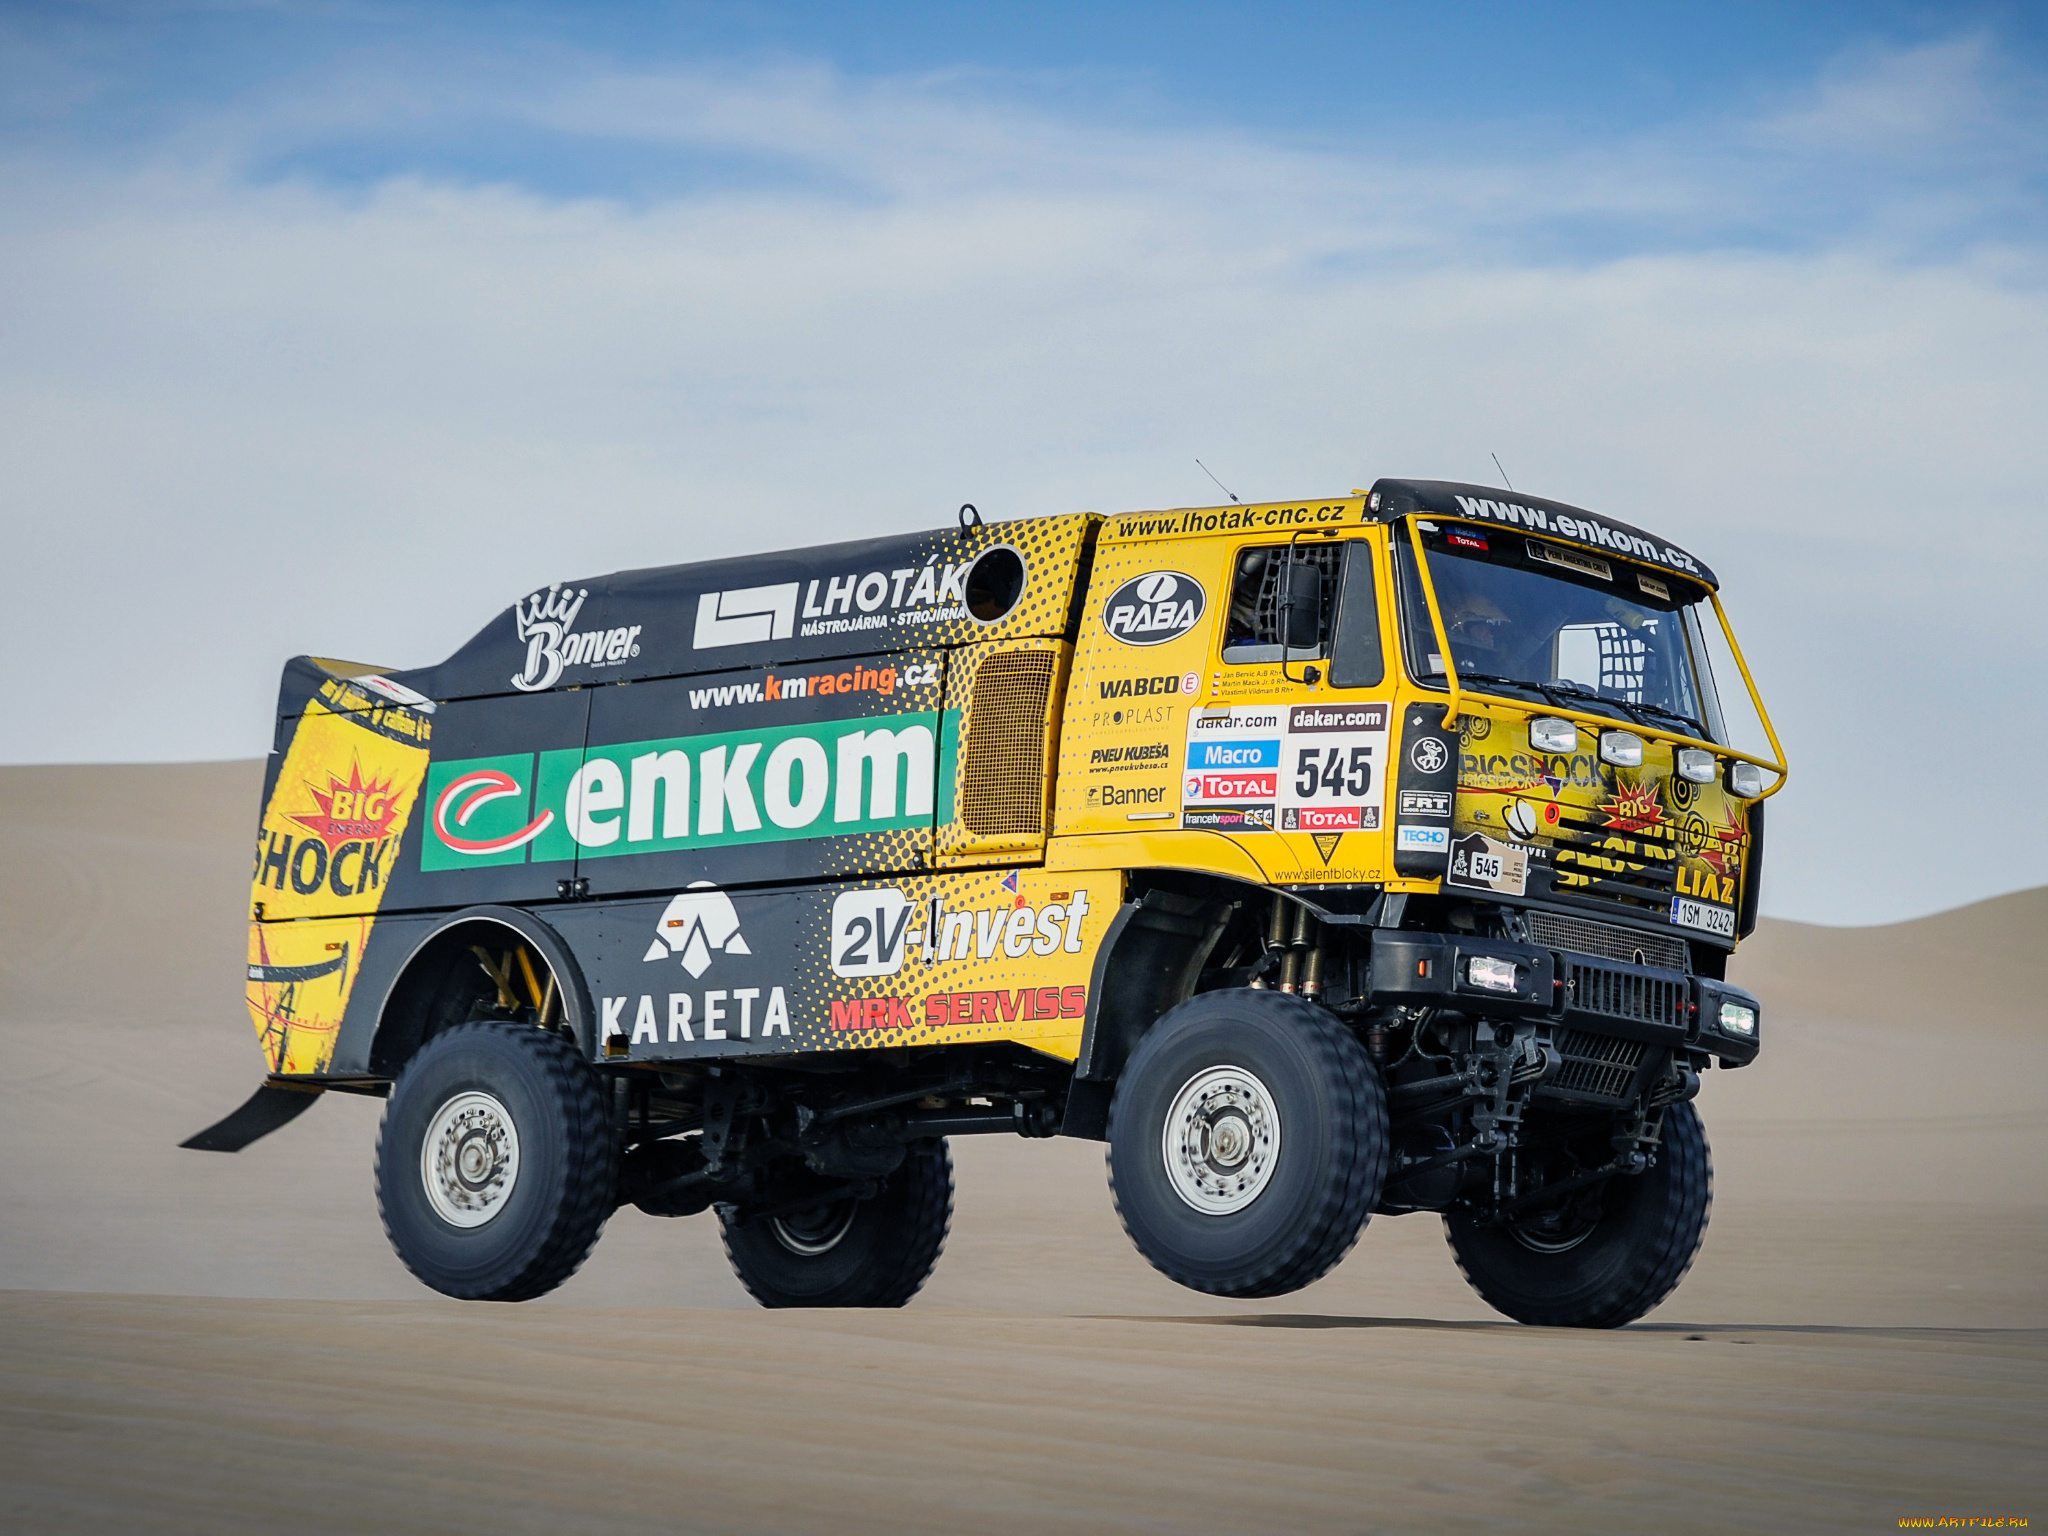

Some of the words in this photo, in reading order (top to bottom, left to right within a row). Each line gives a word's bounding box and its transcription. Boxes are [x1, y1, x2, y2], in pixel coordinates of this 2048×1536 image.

[1118, 502, 1346, 537] www.lhotak-cnc.cz
[1455, 494, 1700, 573] www.enkom.cz
[802, 554, 974, 619] LHOTÁK
[801, 614, 888, 637] NÁSTROJÁRNA
[897, 606, 966, 627] STROJÍRNA
[1109, 599, 1196, 634] RABA
[688, 661, 939, 711] www.kmracing.cz
[1100, 676, 1180, 699] WABCO
[1092, 706, 1175, 727] PROPLAST
[1294, 709, 1381, 728] dakar.com
[1090, 747, 1124, 764] PNEU
[1124, 741, 1169, 761] KUBEŠA
[1205, 745, 1262, 765] Macro
[1089, 761, 1169, 774] www.pneukubesa.cz
[1295, 747, 1373, 798] 545
[565, 725, 935, 848] enkom
[1102, 785, 1167, 806] Banner
[1206, 776, 1275, 796] TOTAL
[330, 790, 386, 822] BIG
[1403, 797, 1449, 809] FRT
[1619, 796, 1651, 817] BIG
[1185, 812, 1244, 826] francetvsport
[1302, 811, 1359, 826] TOTAL
[1403, 829, 1445, 843] TECHO
[1275, 868, 1381, 882] www.silentbloky.cz
[1475, 856, 1499, 878] 545
[1676, 866, 1735, 905] LIAZ
[838, 889, 1090, 967] 2V-Invest
[1682, 903, 1701, 925] 1SM
[1706, 909, 1731, 932] 3242
[601, 986, 792, 1047] KARETA
[830, 996, 914, 1033] MRK
[925, 985, 1087, 1027] SERVISS
